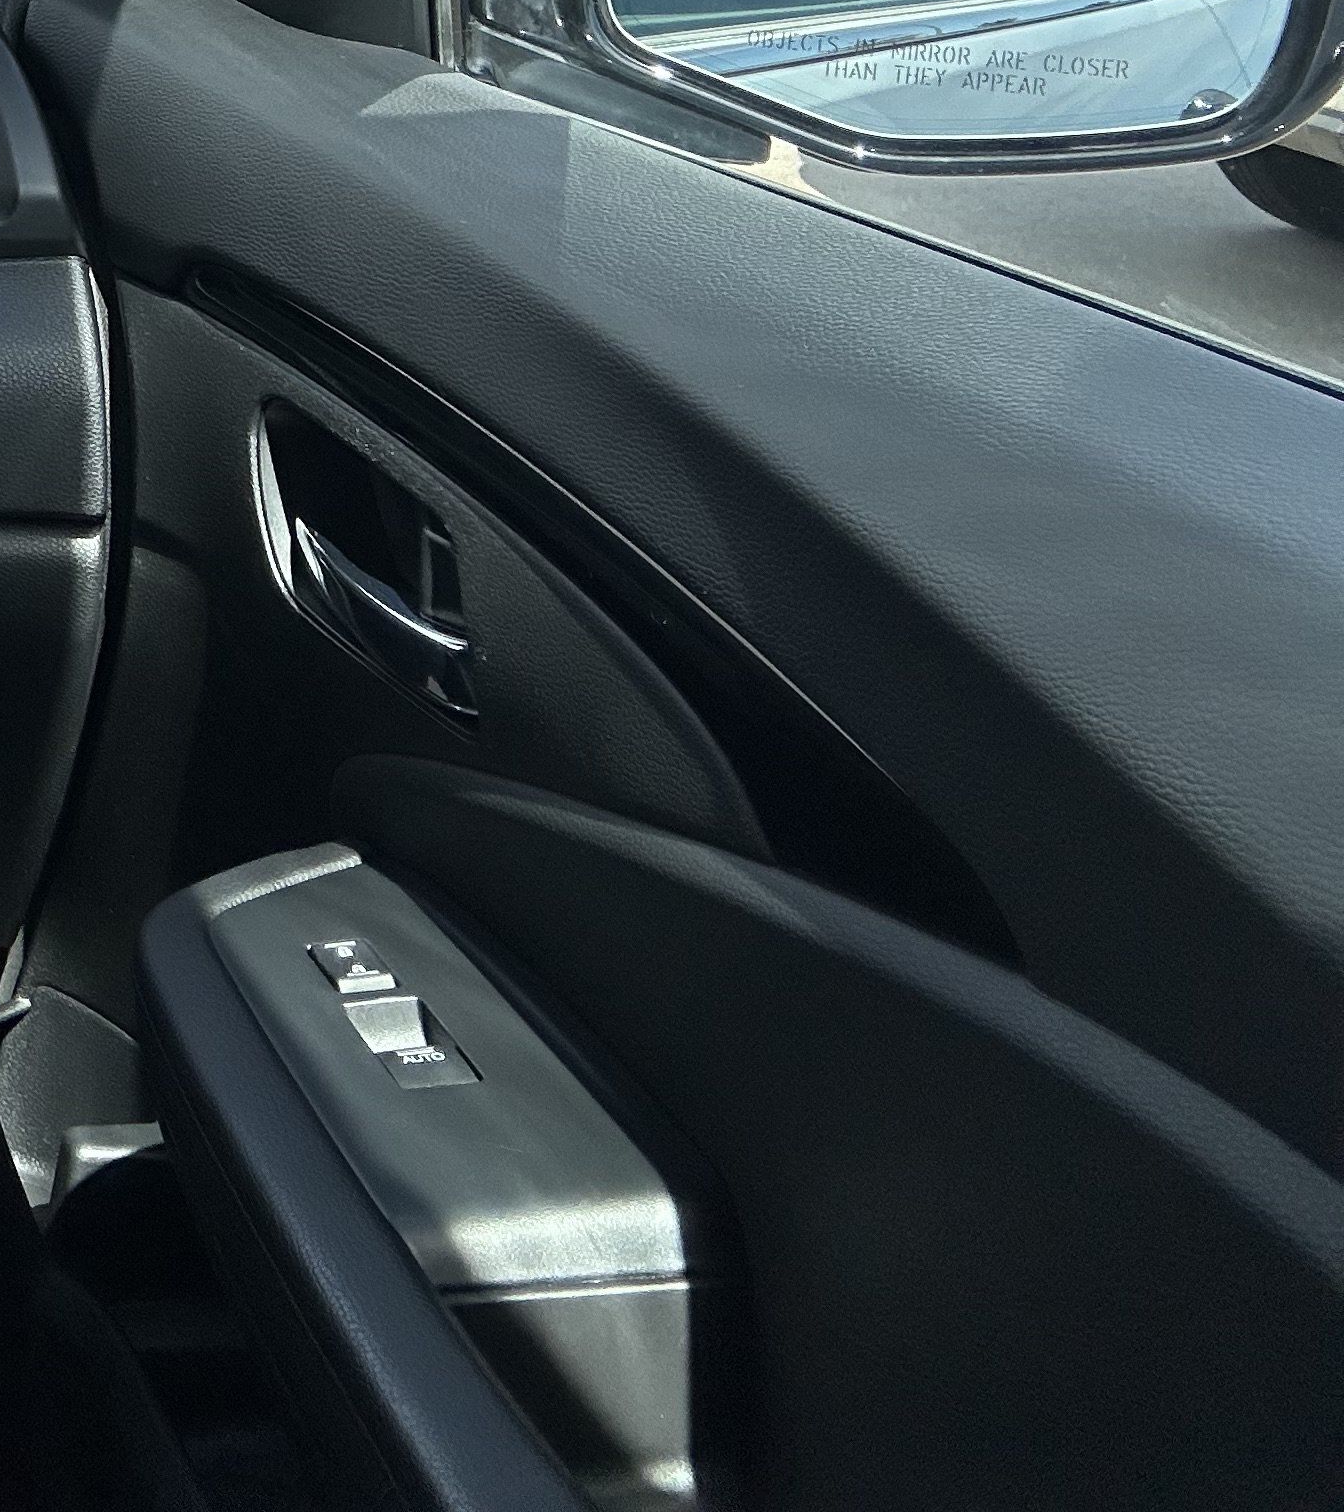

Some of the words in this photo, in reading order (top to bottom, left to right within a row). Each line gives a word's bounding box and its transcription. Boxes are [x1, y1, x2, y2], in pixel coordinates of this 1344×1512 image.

[747, 30, 840, 53] OBJECTS
[891, 43, 971, 66] MIRROR
[985, 49, 1029, 71] ARE
[1043, 54, 1129, 80] CLOSER
[824, 60, 878, 81] THAN
[894, 64, 947, 87] THEY
[961, 71, 1047, 97] APPEAR
[402, 1051, 446, 1065] AUTO
